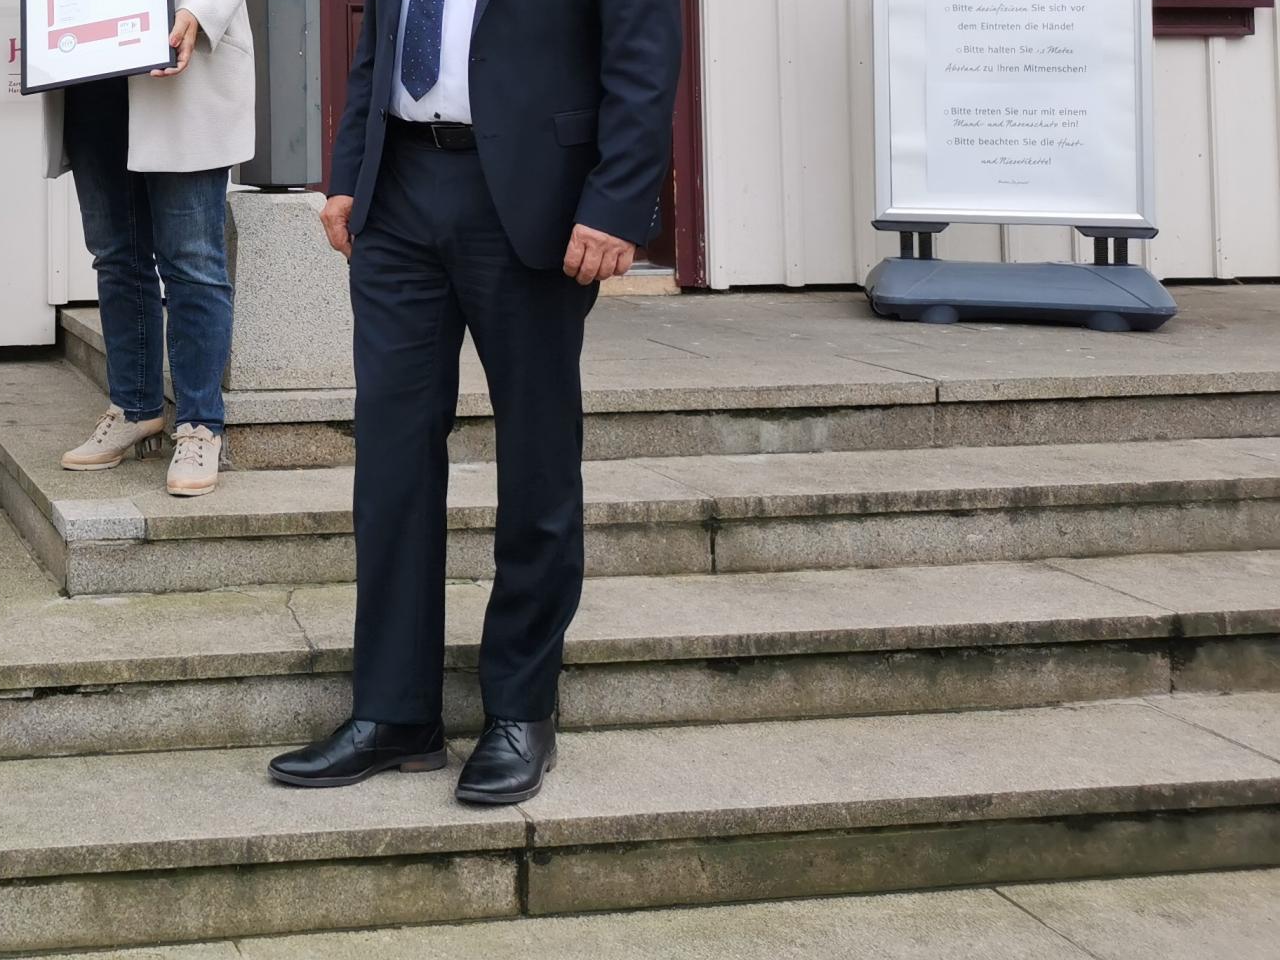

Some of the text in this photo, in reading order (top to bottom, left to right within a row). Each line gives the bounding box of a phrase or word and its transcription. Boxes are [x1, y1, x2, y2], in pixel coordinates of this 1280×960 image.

[952, 3, 974, 12] Bitte
[975, 3, 1028, 16] desinfizieren
[1031, 3, 1046, 12] Sie
[1049, 3, 1067, 12] sich
[957, 21, 1074, 31] dem Eintreten die Hände!
[963, 45, 984, 54] Bitte
[988, 45, 1016, 54] halten
[1019, 45, 1034, 54] Sie
[945, 63, 1087, 73] Abstand zu Ihren Mitmenschen!
[951, 107, 1087, 117] Bitte treten Sie nur mit einem
[987, 120, 1004, 128] und
[1006, 119, 1059, 128] Nasenschutz
[1061, 120, 1079, 128] ein!
[954, 137, 975, 146] Bitte
[978, 137, 1019, 146] beachten
[1022, 137, 1037, 146] Sie
[1040, 137, 1055, 146] die
[981, 157, 998, 165] und
